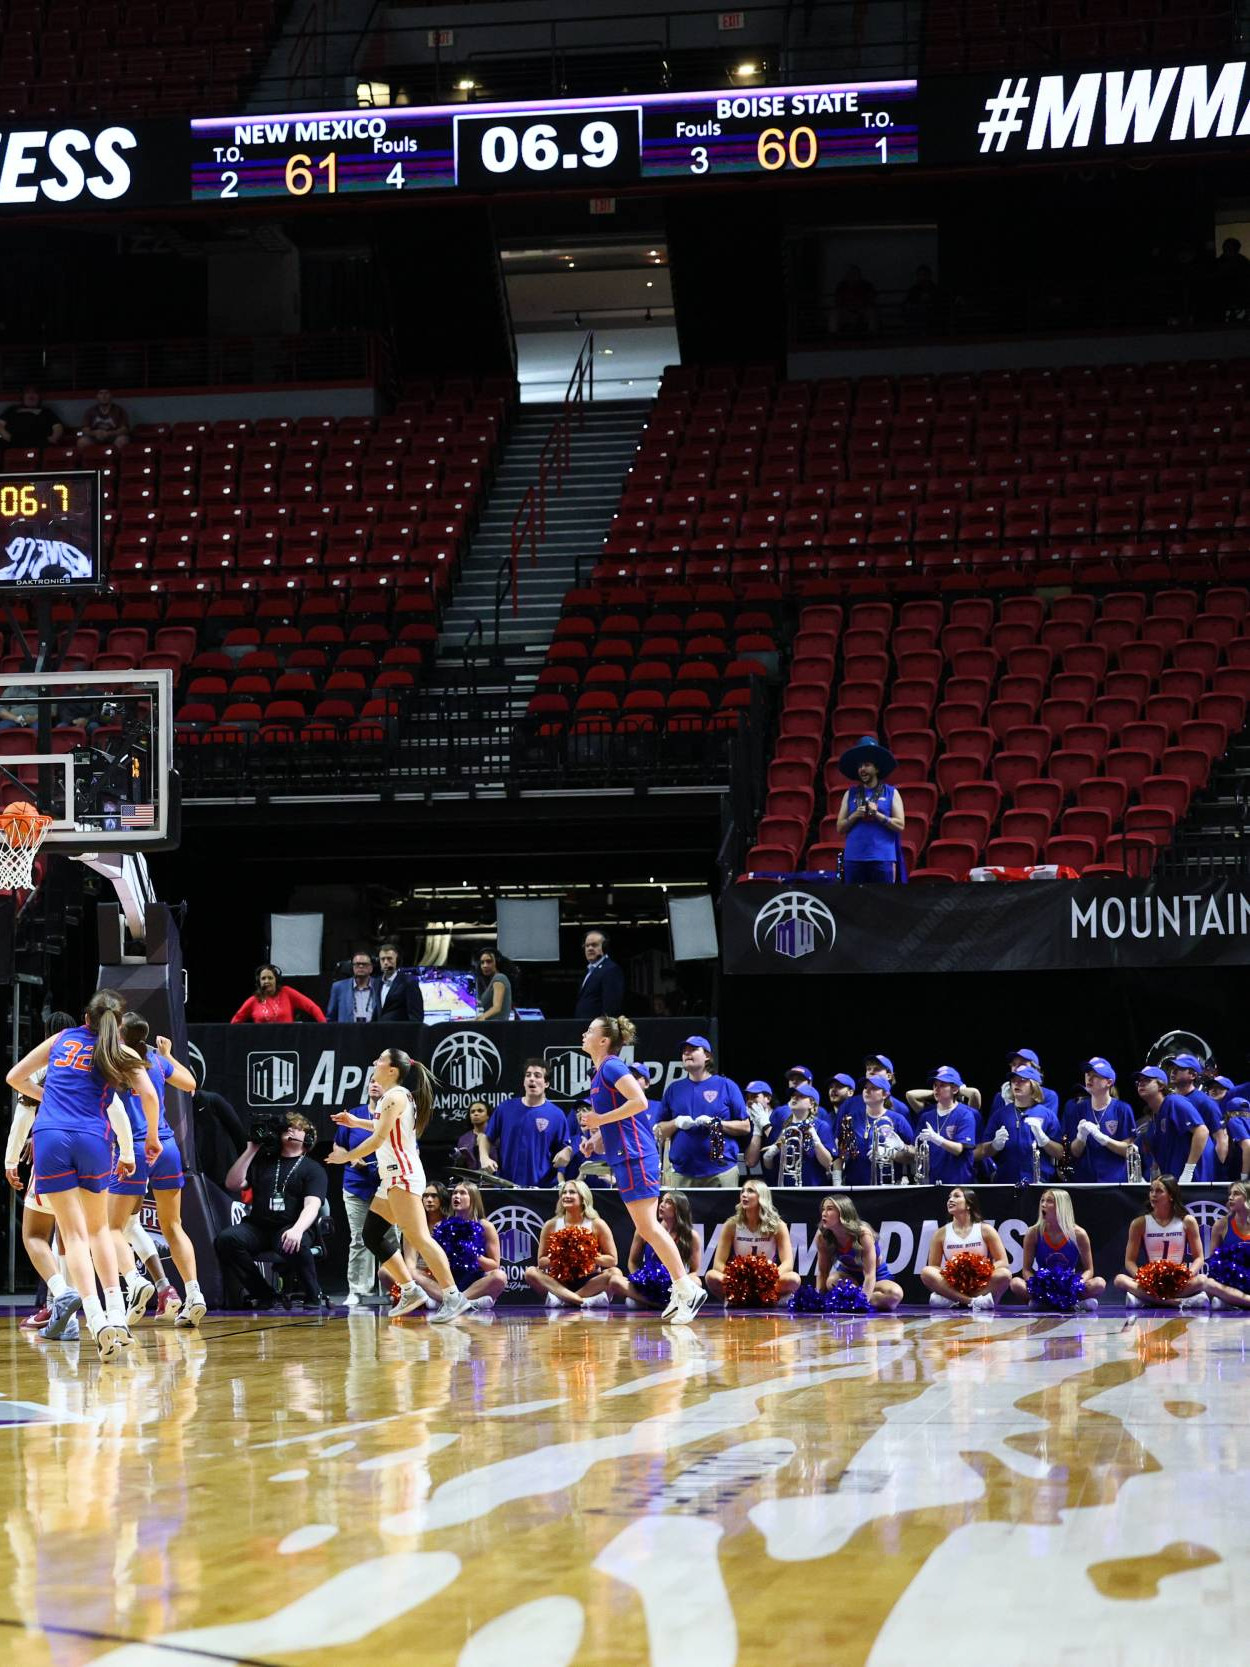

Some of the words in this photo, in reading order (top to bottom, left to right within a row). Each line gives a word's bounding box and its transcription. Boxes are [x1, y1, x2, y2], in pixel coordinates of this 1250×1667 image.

[716, 96, 785, 120] BOISE
[791, 92, 858, 115] STATE
[234, 123, 289, 145] NEW
[295, 117, 387, 142] MEXICO
[676, 120, 721, 139] Fouls
[861, 112, 894, 129] T.O.
[213, 146, 244, 163] T.O.
[373, 136, 418, 154] Fouls
[481, 121, 618, 173] 06.9
[756, 126, 817, 171] 60
[875, 137, 888, 164] 1
[285, 152, 336, 196] 61
[690, 147, 709, 174] 3
[220, 171, 239, 198] 2
[386, 162, 405, 190] 4
[54, 1039, 95, 1073] 32
